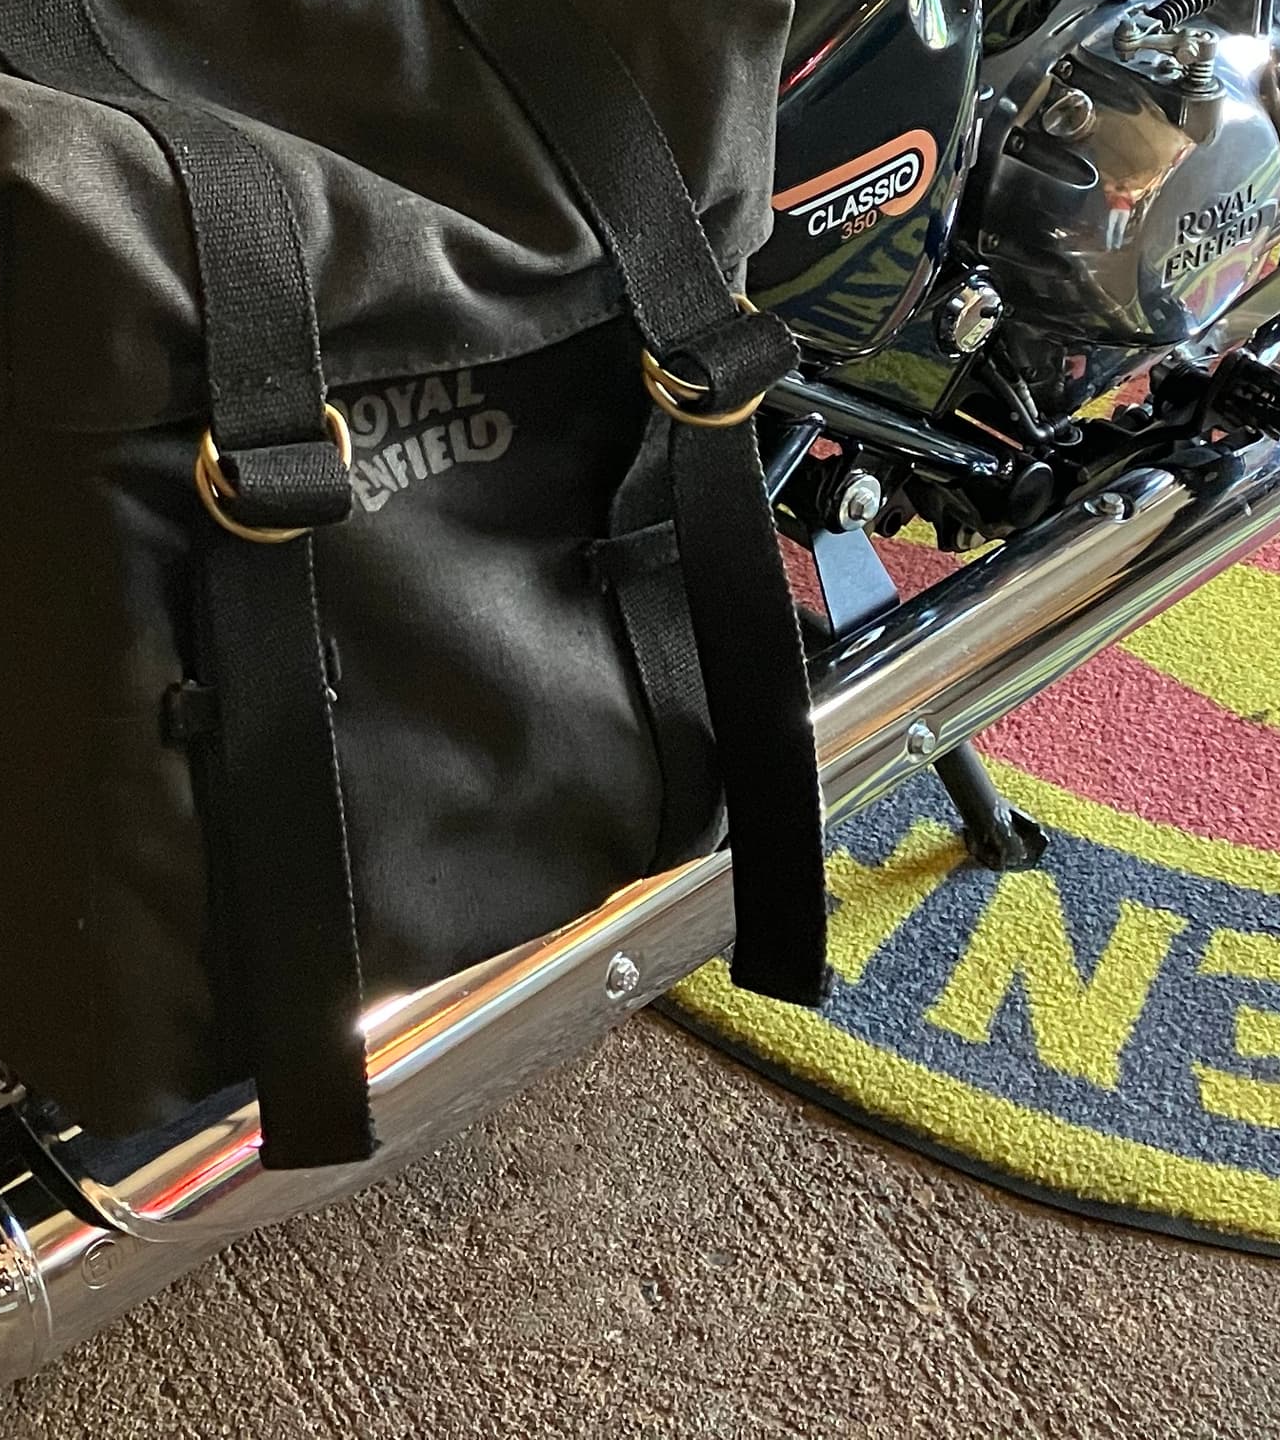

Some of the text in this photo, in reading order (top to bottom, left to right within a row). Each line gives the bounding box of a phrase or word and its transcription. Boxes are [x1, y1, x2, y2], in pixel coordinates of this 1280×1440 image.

[807, 165, 913, 237] CLASSIC
[839, 209, 879, 251] 350
[1176, 183, 1258, 246] ROYAL
[1161, 207, 1264, 289] ENFIELD
